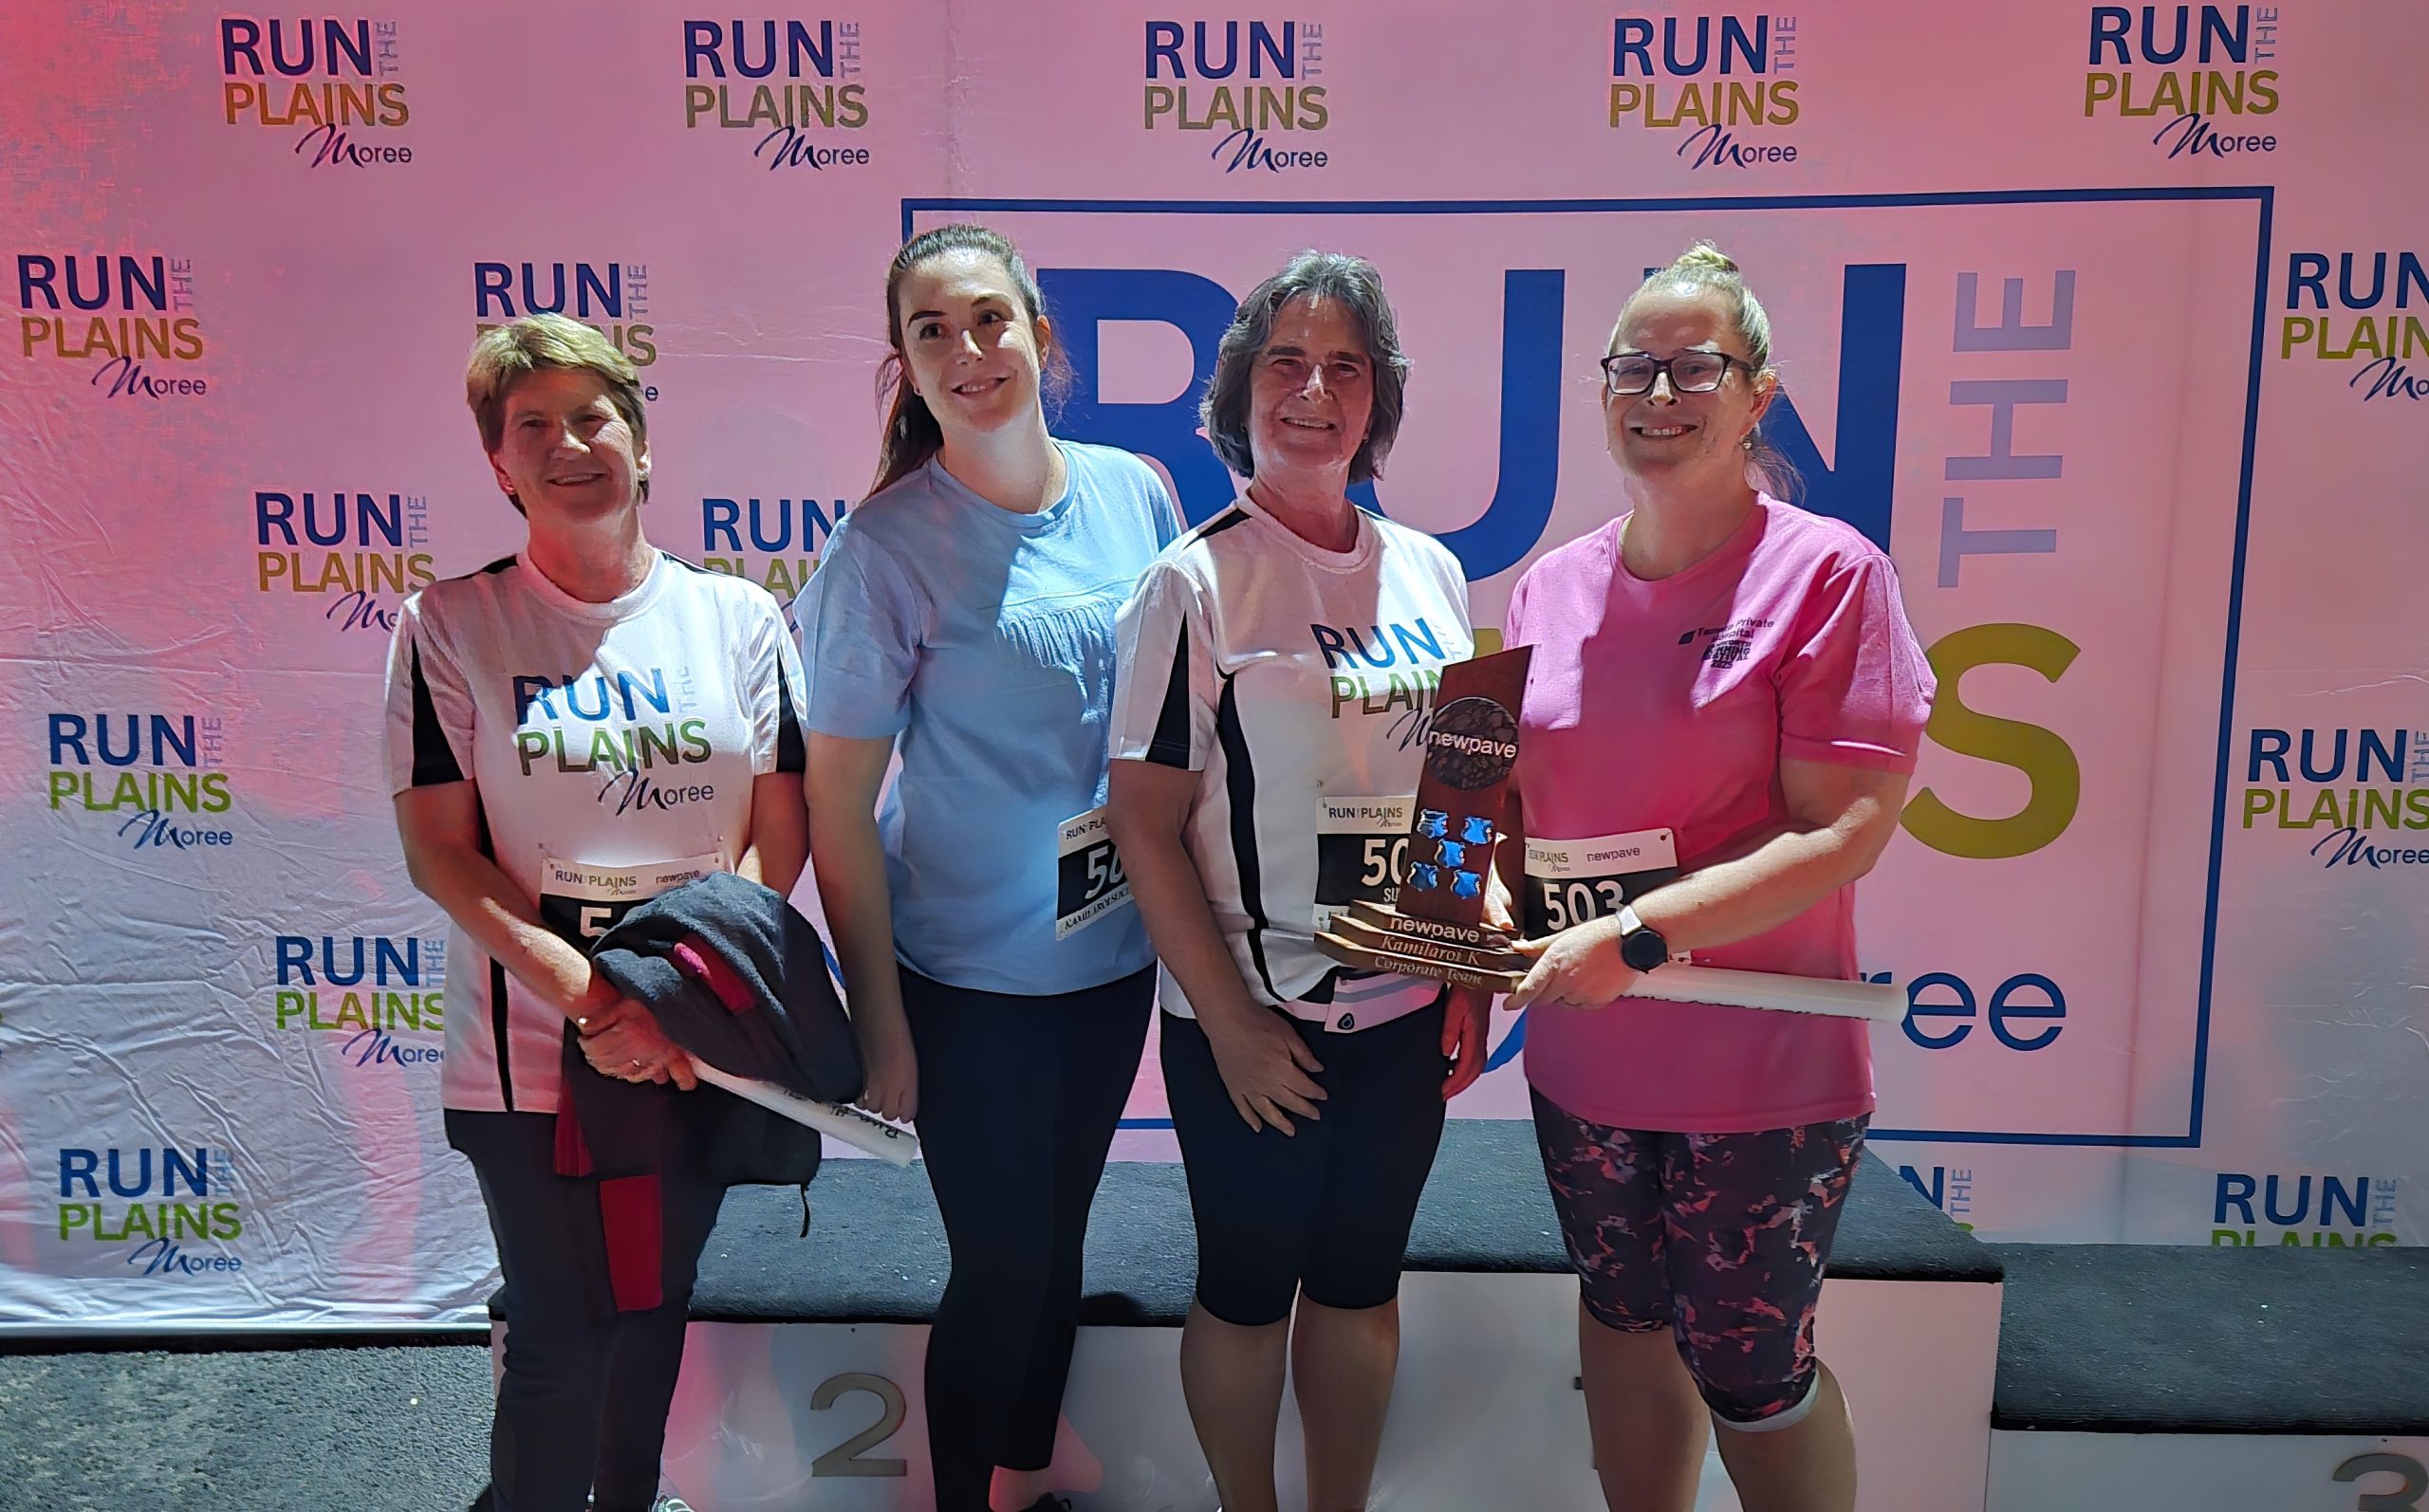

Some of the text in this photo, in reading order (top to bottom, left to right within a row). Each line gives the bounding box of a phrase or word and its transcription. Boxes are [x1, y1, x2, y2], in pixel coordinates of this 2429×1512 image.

[220, 19, 397, 76] RUN THE
[683, 20, 860, 78] RUN THE
[1145, 21, 1323, 80] RUN THE
[1613, 15, 1796, 77] RUN THE
[2088, 5, 2278, 65] RUN THE
[225, 83, 410, 126] PLAINS
[686, 84, 868, 128] PLAINS
[1144, 85, 1328, 130] PLAINS
[1610, 81, 1800, 127] PLAINS
[2085, 70, 2279, 117] PLAINS
[295, 123, 412, 169] Moree
[754, 125, 869, 171] Moree
[1212, 128, 1328, 174] Moree
[1677, 123, 1798, 171] Moree
[2153, 112, 2277, 159] Moree
[17, 254, 193, 311] RUN THE
[474, 263, 648, 320] RUN THE
[22, 317, 203, 360] PLAINS
[2281, 316, 2429, 360] PLAIN
[92, 356, 206, 399] Moree
[1938, 269, 2075, 588] THE
[254, 491, 428, 548] RUN THE
[702, 498, 846, 552] RUN
[258, 551, 436, 594] PLAINS
[1310, 618, 1446, 671] RUN
[513, 668, 670, 727] RUN
[1330, 670, 1442, 719] PLAIN
[47, 713, 223, 767] RUN THE
[517, 720, 712, 777] PLAINS
[1429, 730, 1517, 759] newpave
[2248, 729, 2407, 783] RUN
[48, 770, 232, 813] PLAINS
[598, 768, 714, 817] Moree
[1329, 807, 1355, 819] RUN
[1361, 806, 1403, 819] PLAINS
[2243, 789, 2429, 830] PLAINS
[118, 809, 233, 850] Moree
[2310, 826, 2429, 870] Moree
[1586, 847, 1640, 862] newpave
[555, 870, 583, 884] RUN
[588, 876, 637, 888] PLAINS
[1543, 880, 1624, 931] 503
[1390, 917, 1480, 943] newpave
[276, 935, 444, 986] RUN THE
[59, 1148, 208, 1198] RUN
[1950, 1169, 1972, 1216] THE
[58, 1202, 243, 1241] PLAINS
[2215, 1172, 2369, 1227] RUN
[127, 1237, 242, 1276] Moree
[811, 1374, 907, 1477] 2
